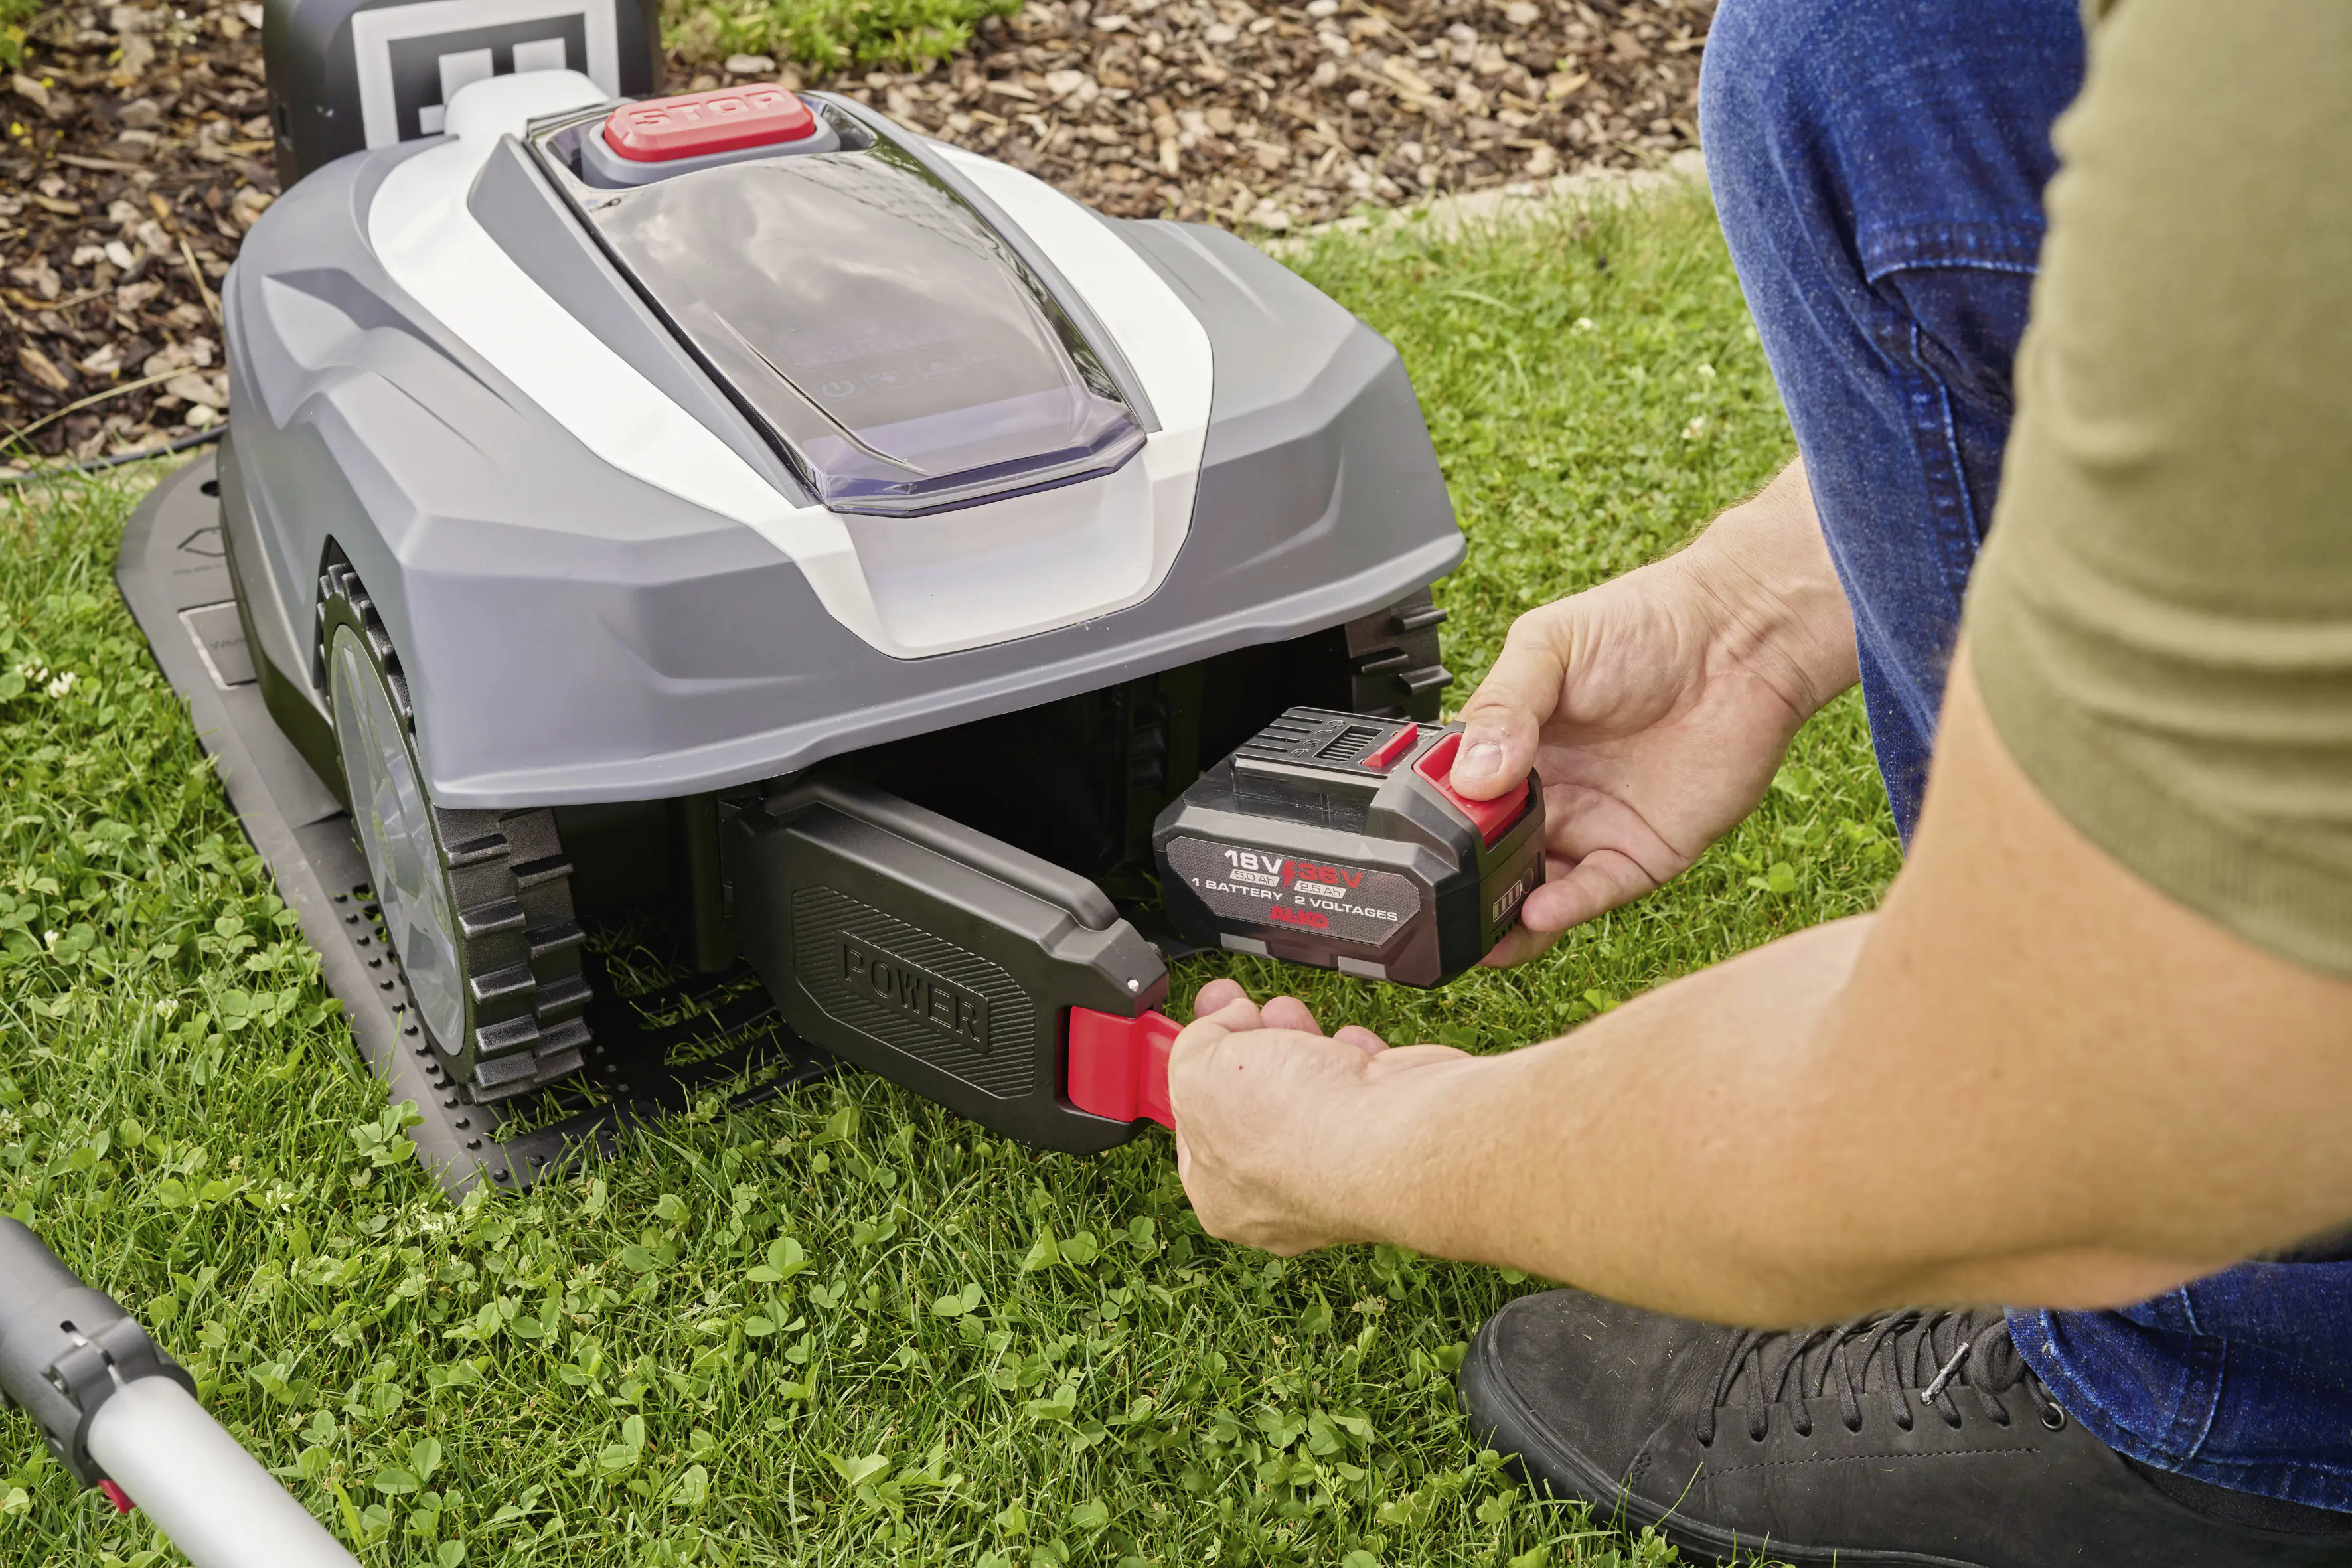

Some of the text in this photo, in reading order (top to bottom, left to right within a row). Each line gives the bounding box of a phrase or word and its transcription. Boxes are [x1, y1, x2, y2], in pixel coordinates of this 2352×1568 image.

[628, 90, 785, 126] STOP
[1224, 850, 1363, 888] 18V 36V
[1235, 870, 1275, 885] 5.0 Ah
[1192, 878, 1398, 921] 1 BATTERY 2 VOLTAGES
[1300, 882, 1341, 897] 2.5 Ah
[1269, 905, 1330, 929] AL-KO
[842, 943, 980, 1043] POWER
